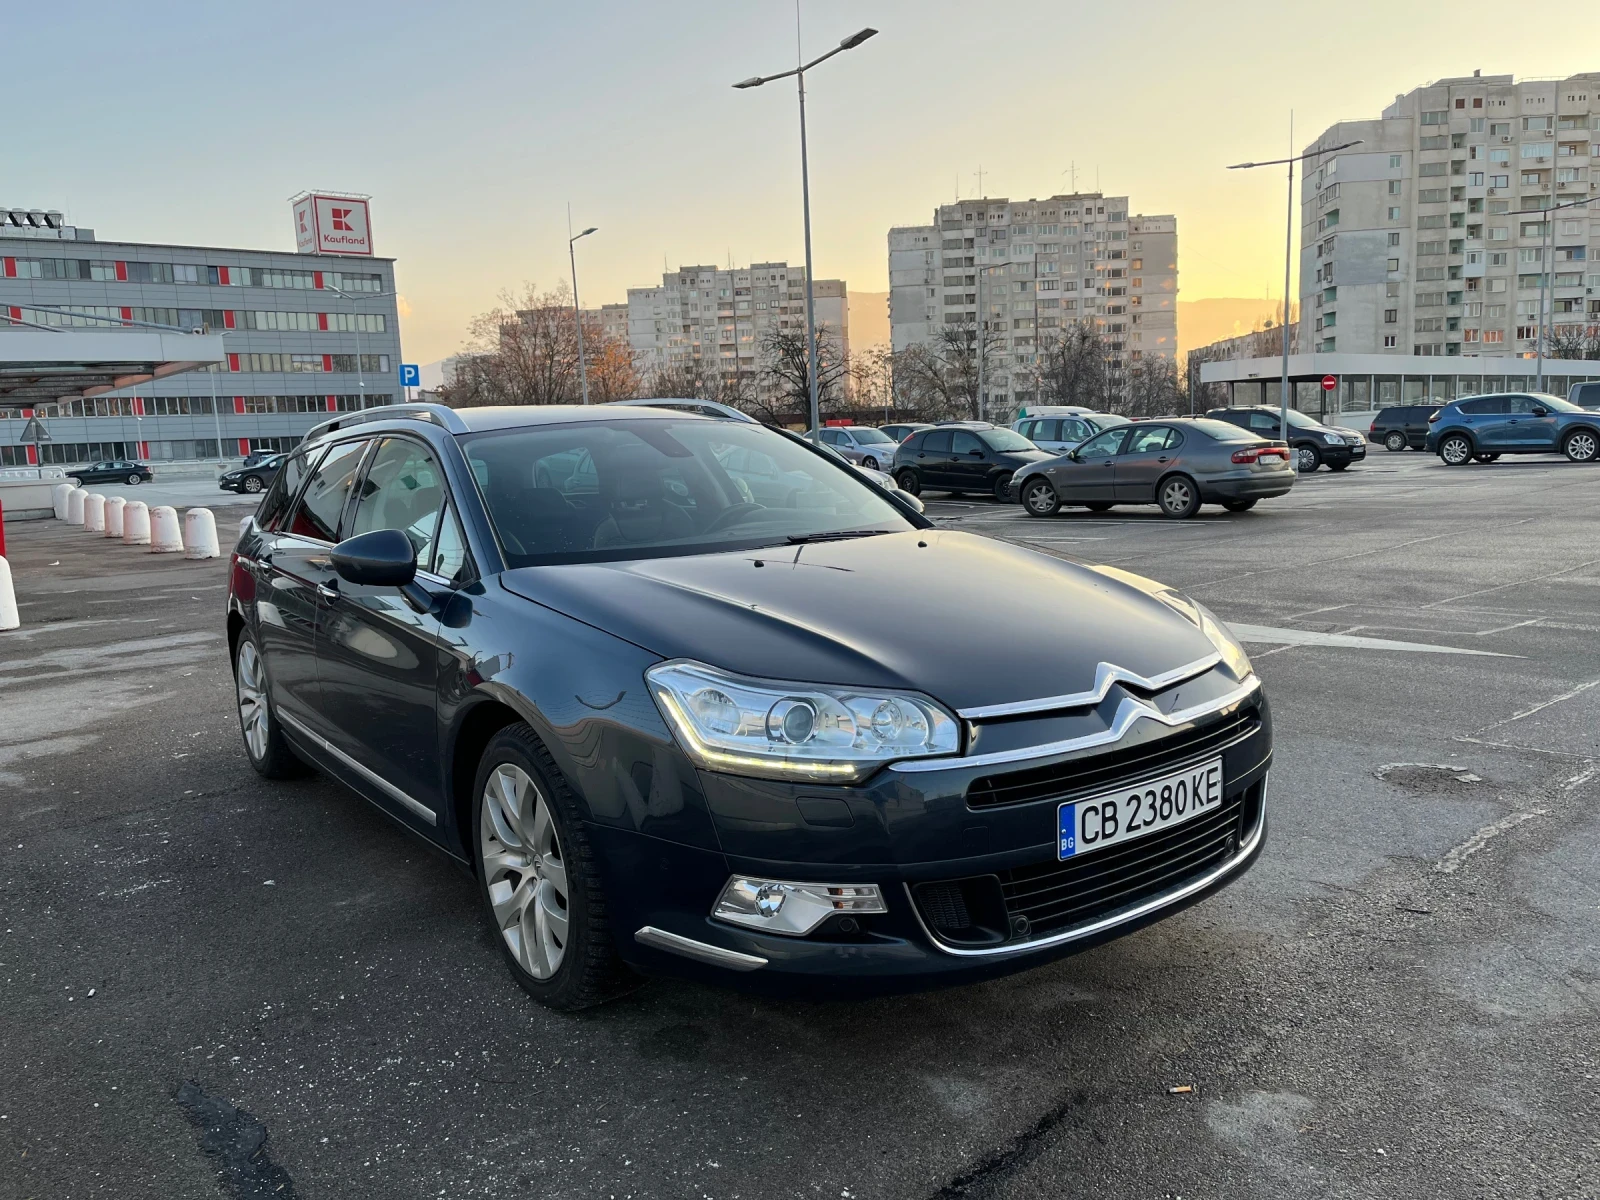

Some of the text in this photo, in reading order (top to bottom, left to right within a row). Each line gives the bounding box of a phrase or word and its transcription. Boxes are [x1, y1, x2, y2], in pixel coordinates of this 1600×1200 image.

[332, 208, 354, 231] K
[323, 234, 365, 245] Kaufland
[404, 366, 415, 384] P
[1081, 766, 1219, 844] CB 2380 KE
[1061, 837, 1074, 851] BG
